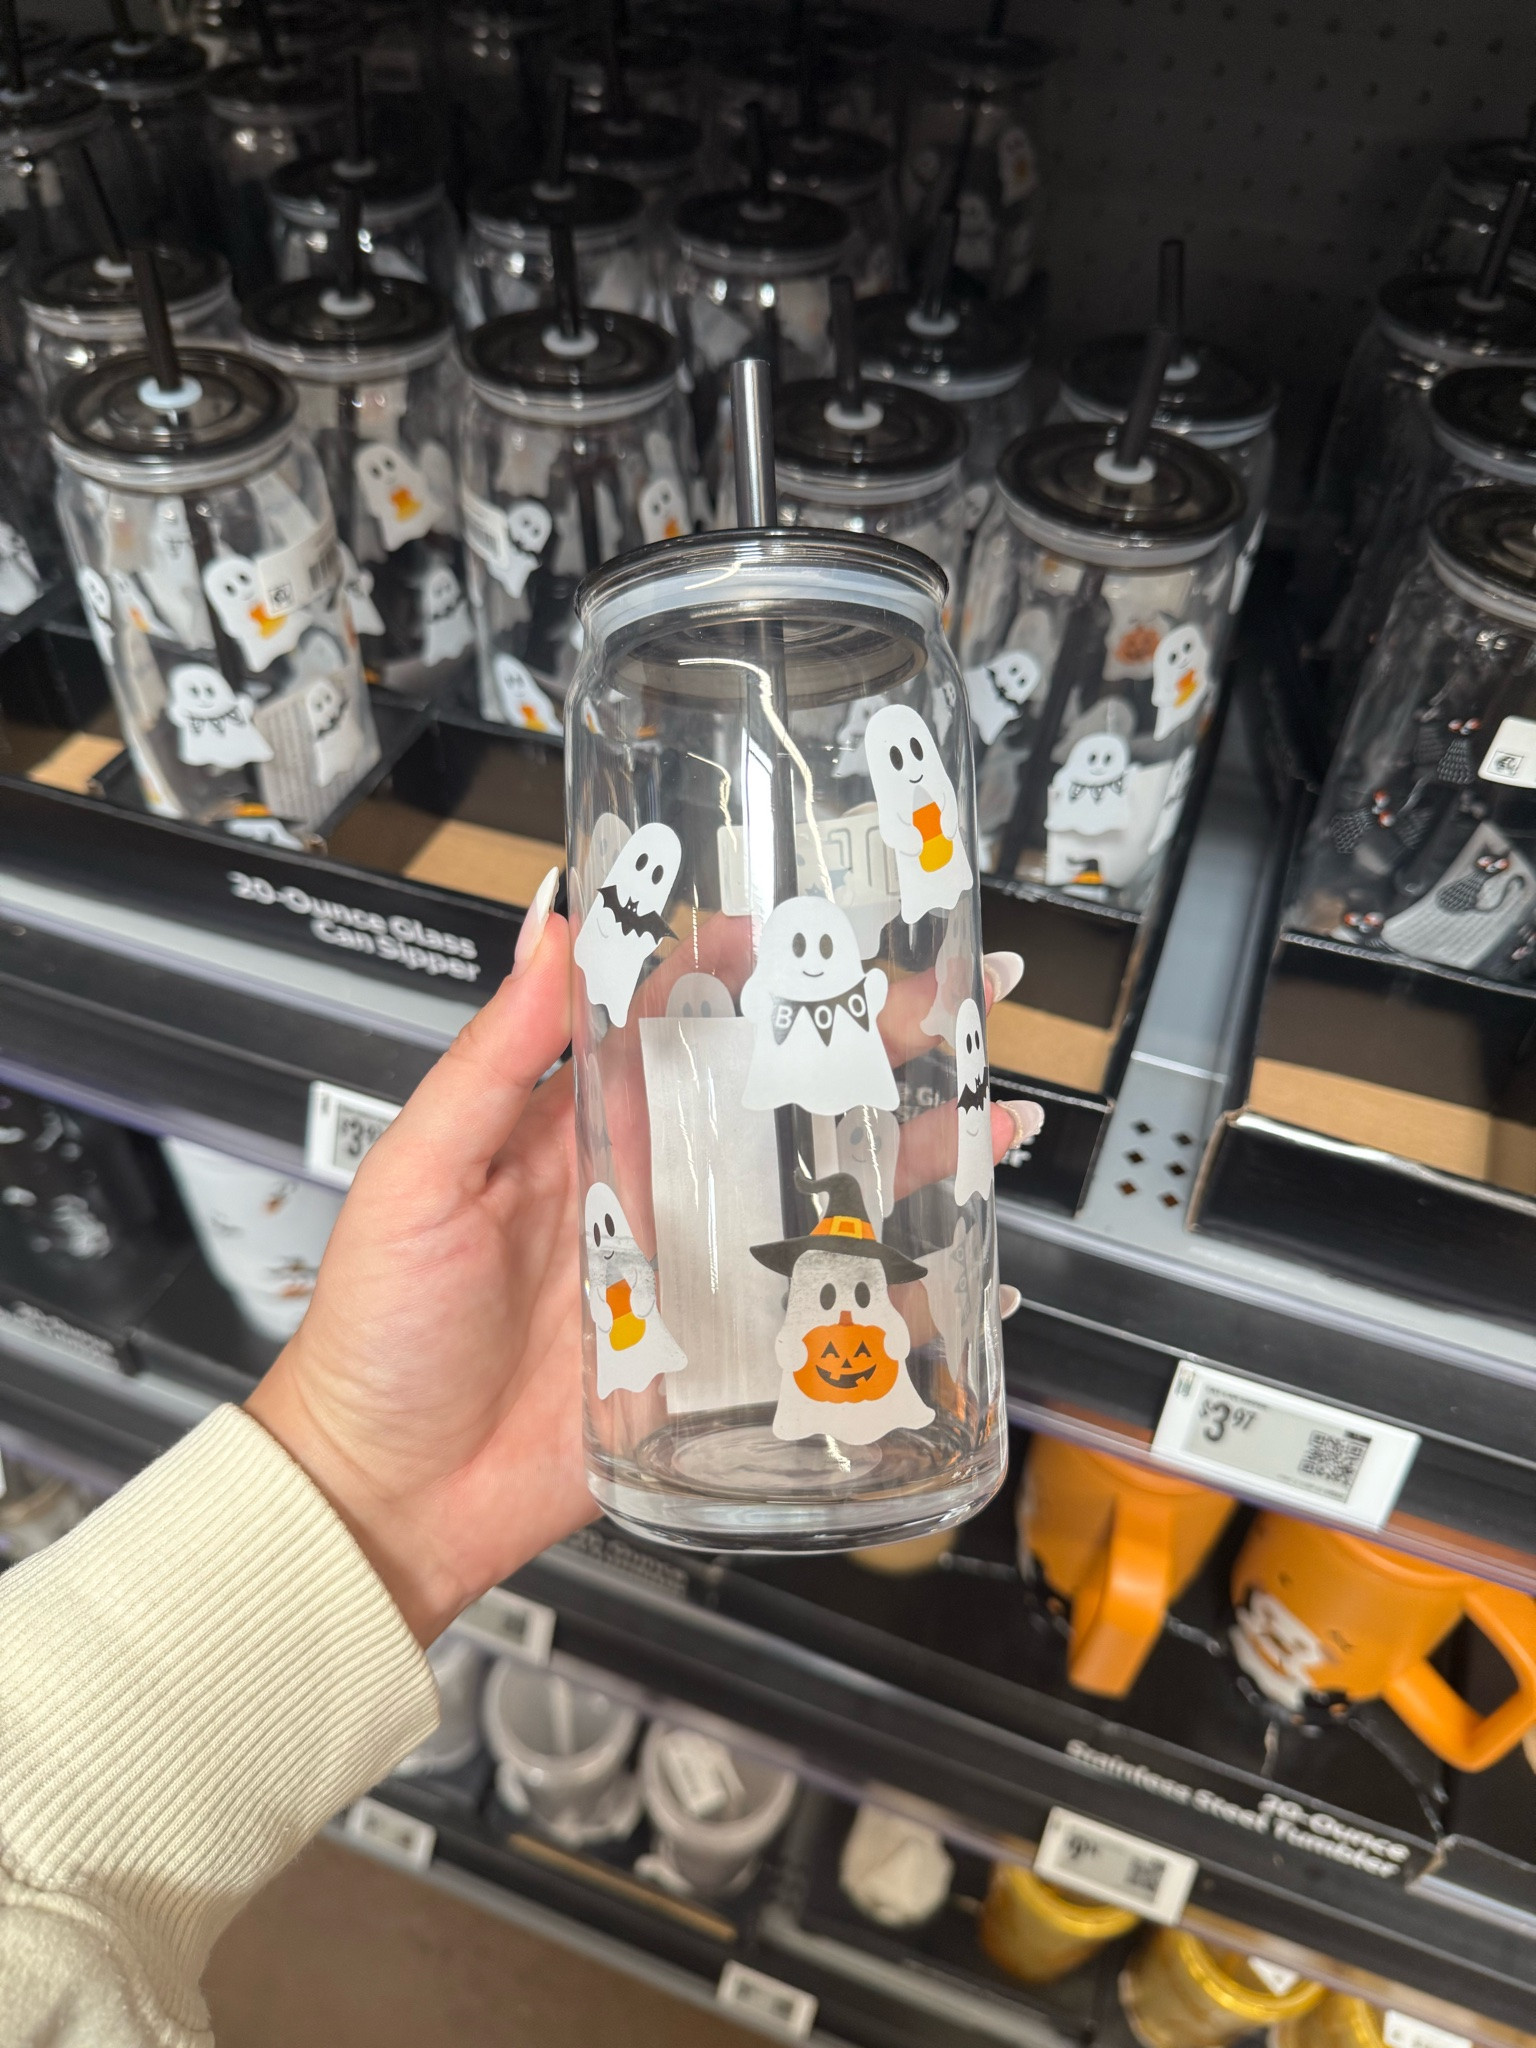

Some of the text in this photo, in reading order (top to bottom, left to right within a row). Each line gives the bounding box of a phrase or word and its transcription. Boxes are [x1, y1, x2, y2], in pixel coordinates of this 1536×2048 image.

[226, 870, 478, 960] 20-Ounce Glass
[310, 918, 481, 982] Can Sipper
[775, 993, 867, 1030] BOO
